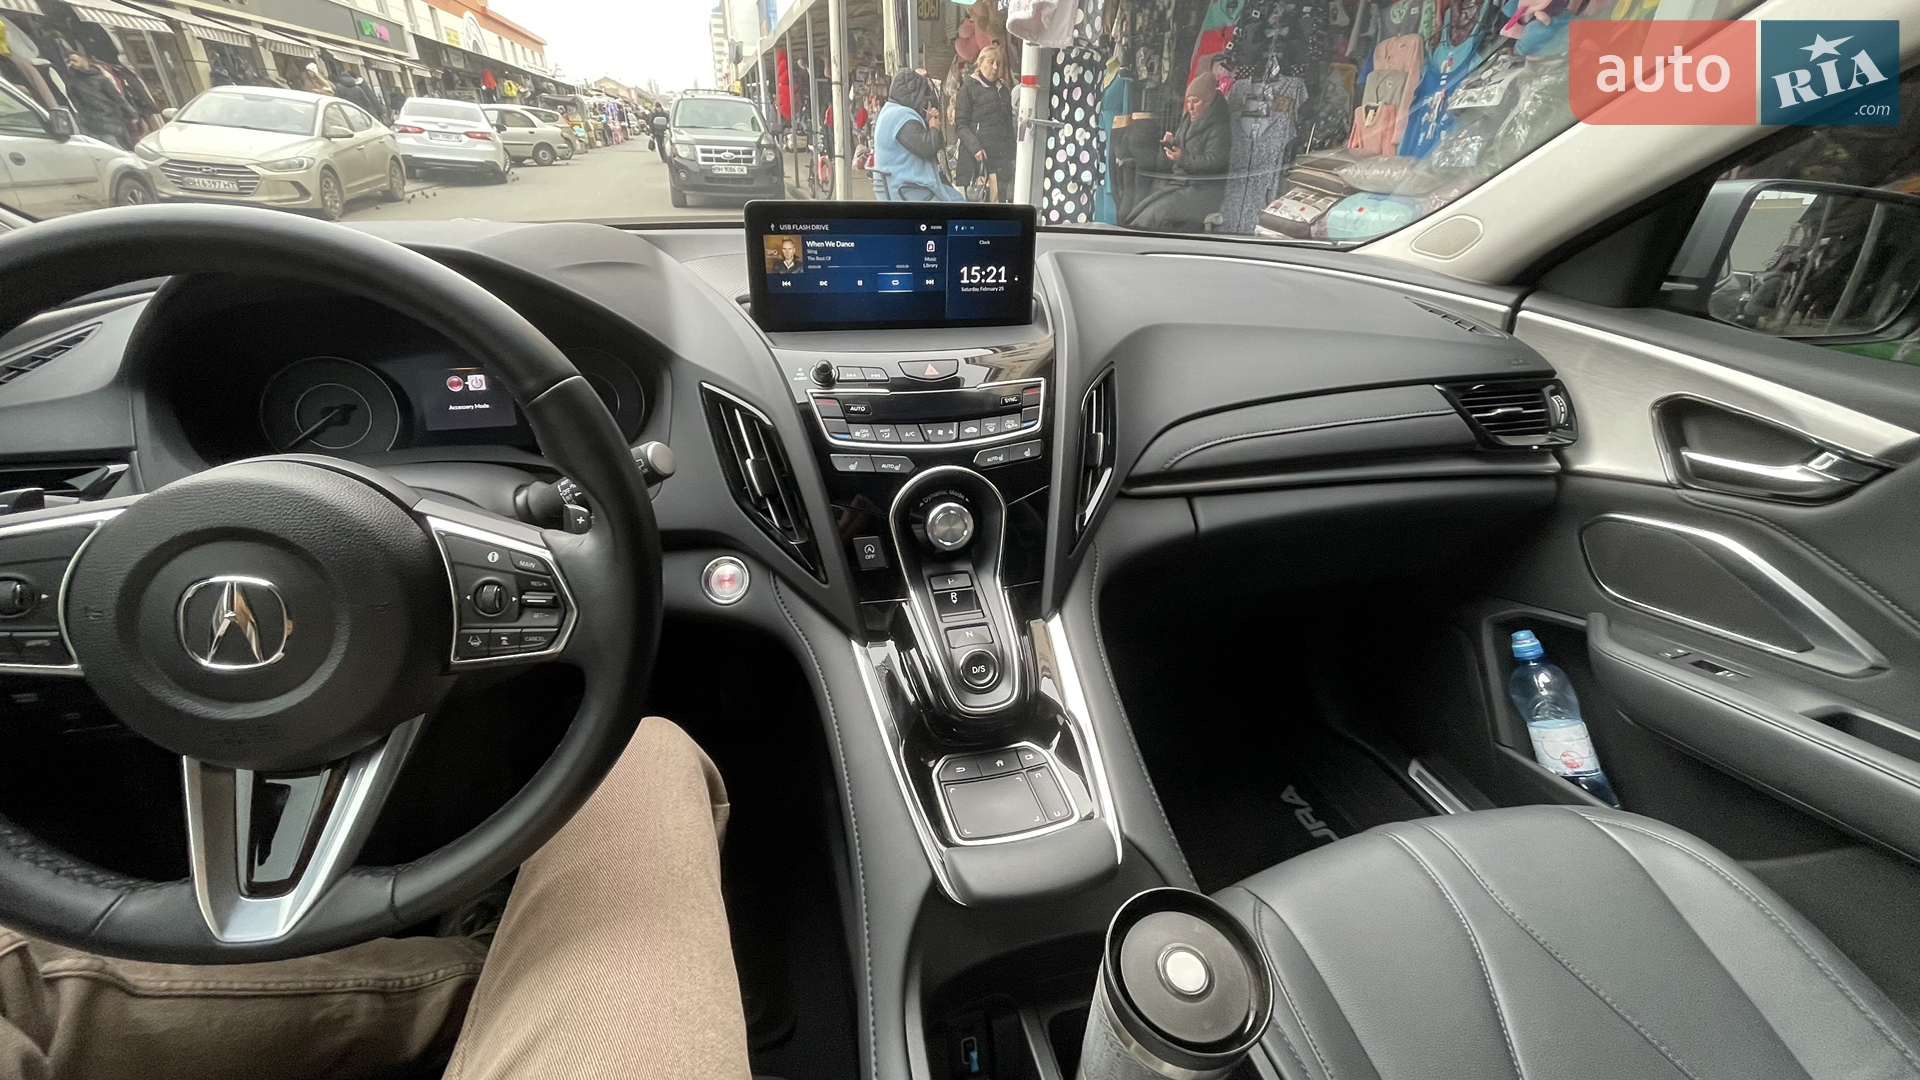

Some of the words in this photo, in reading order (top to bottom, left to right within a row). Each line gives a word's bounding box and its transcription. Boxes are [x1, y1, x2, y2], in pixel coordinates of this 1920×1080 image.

[805, 240, 825, 248] When
[825, 240, 836, 248] We
[836, 240, 855, 248] Dance
[960, 265, 1008, 284] 15:21
[519, 560, 536, 569] MAIN
[950, 592, 958, 600] R
[965, 630, 974, 638] N
[971, 664, 986, 674] D/S
